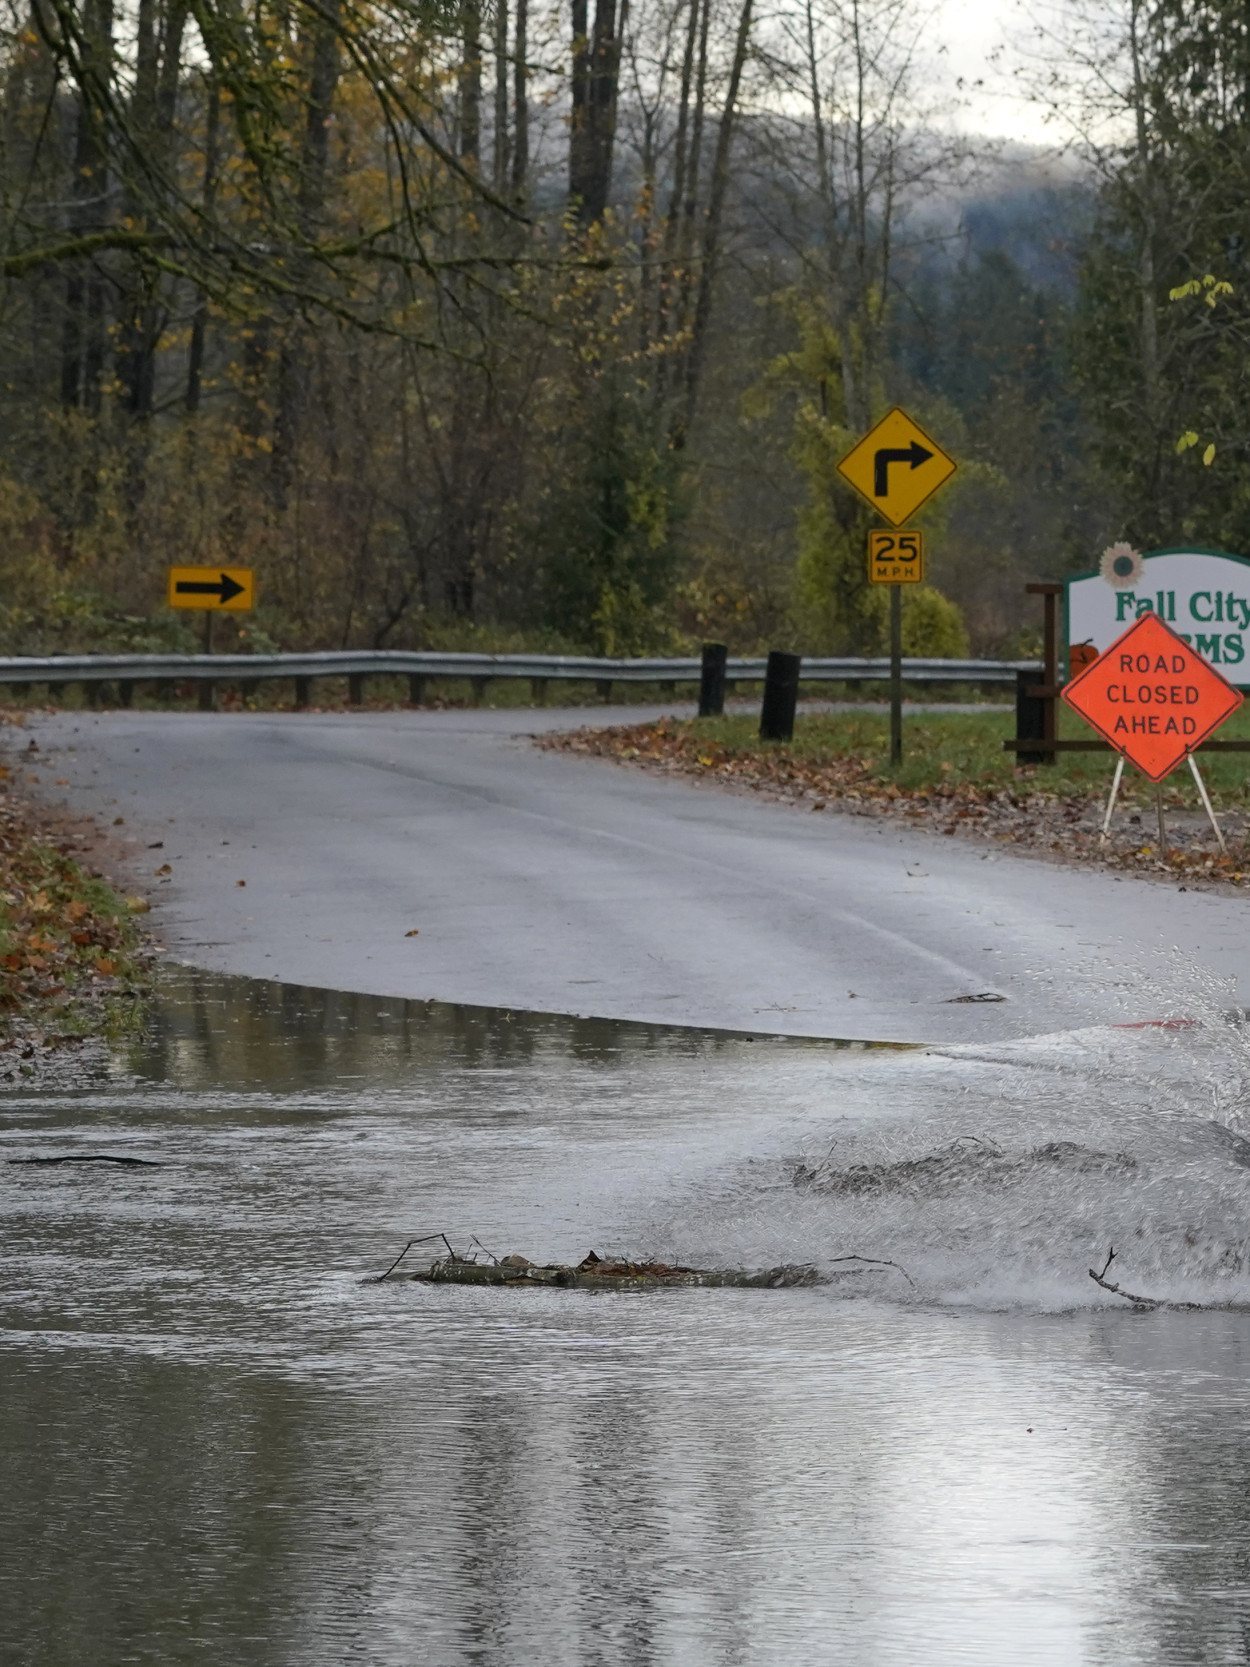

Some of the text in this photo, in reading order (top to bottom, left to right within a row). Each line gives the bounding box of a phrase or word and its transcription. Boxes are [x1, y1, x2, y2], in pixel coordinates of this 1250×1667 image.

[875, 536, 918, 562] 25
[1114, 590, 1177, 621] Fall
[1178, 633, 1245, 665] MS
[1120, 654, 1186, 674] ROAD
[1106, 684, 1199, 705] CLOSED
[1113, 715, 1197, 735] AHEAD
